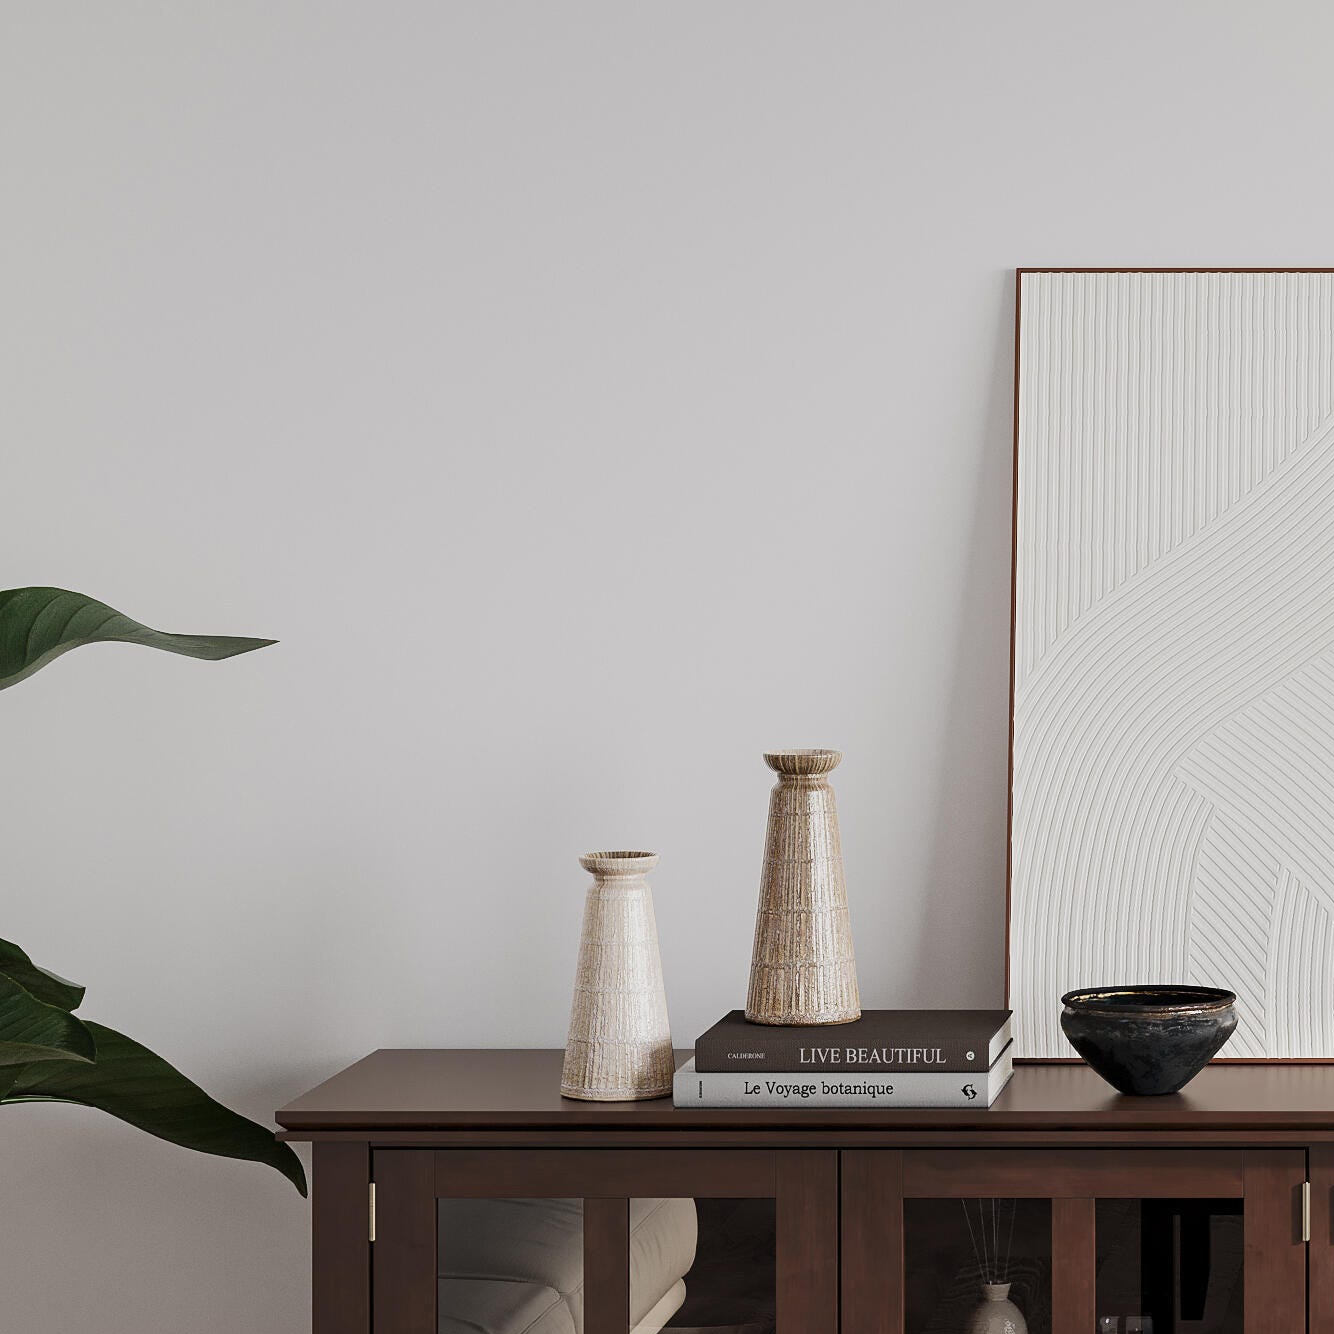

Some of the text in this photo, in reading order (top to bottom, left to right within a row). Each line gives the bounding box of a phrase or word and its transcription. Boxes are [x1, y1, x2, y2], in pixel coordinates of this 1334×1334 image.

[800, 1048, 946, 1063] LIVE BEAUTIFUL
[744, 1082, 893, 1098] Le Voyage botanique
